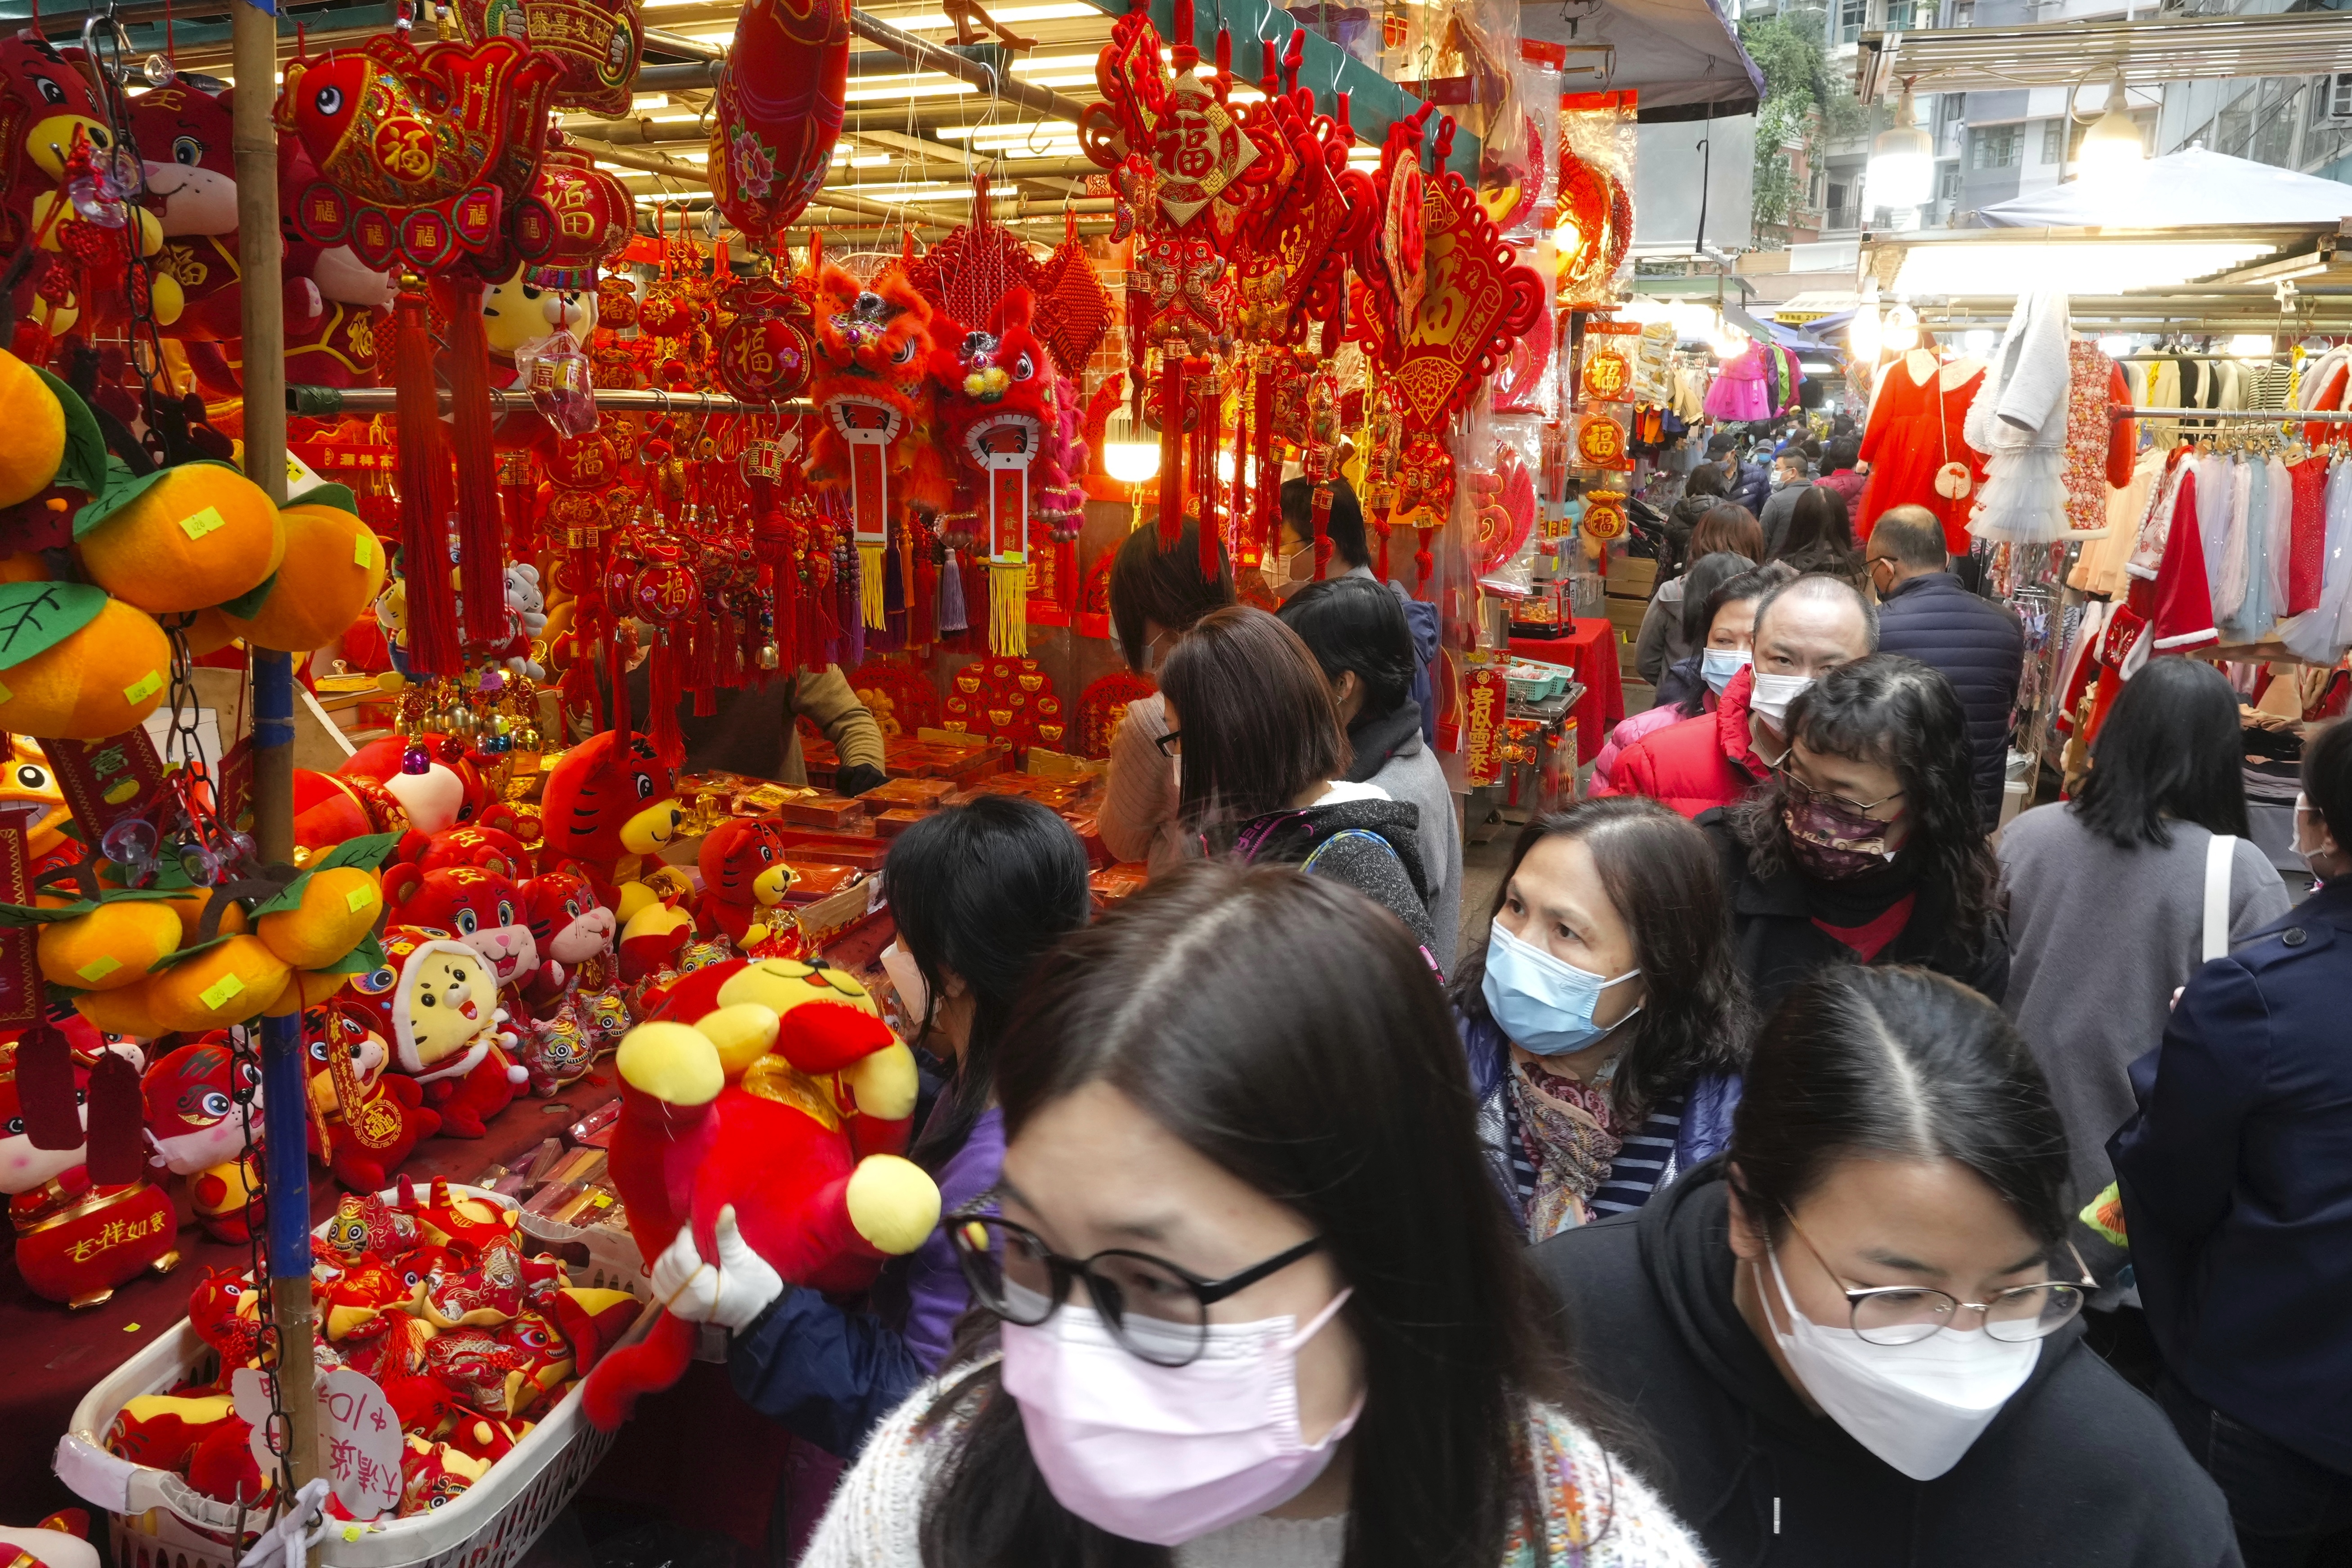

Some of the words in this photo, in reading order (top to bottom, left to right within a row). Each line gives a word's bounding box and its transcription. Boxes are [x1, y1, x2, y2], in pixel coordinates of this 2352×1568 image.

[532, 11, 608, 45] 恭喜发财
[381, 125, 432, 173] 福
[1157, 116, 1214, 179] 福
[315, 200, 337, 222] 福
[468, 204, 487, 226] 福
[540, 174, 594, 240] 福
[366, 224, 385, 247] 福
[415, 225, 436, 247] 福
[522, 218, 540, 239] 福
[734, 326, 773, 374] 福
[1592, 358, 1622, 392] 福
[1585, 425, 1616, 457] 福
[567, 440, 604, 478] 福
[1003, 477, 1018, 549] 恭喜發財
[1594, 512, 1615, 533] 福
[657, 570, 686, 605] 福
[64, 1210, 166, 1263] 吉祥如意
